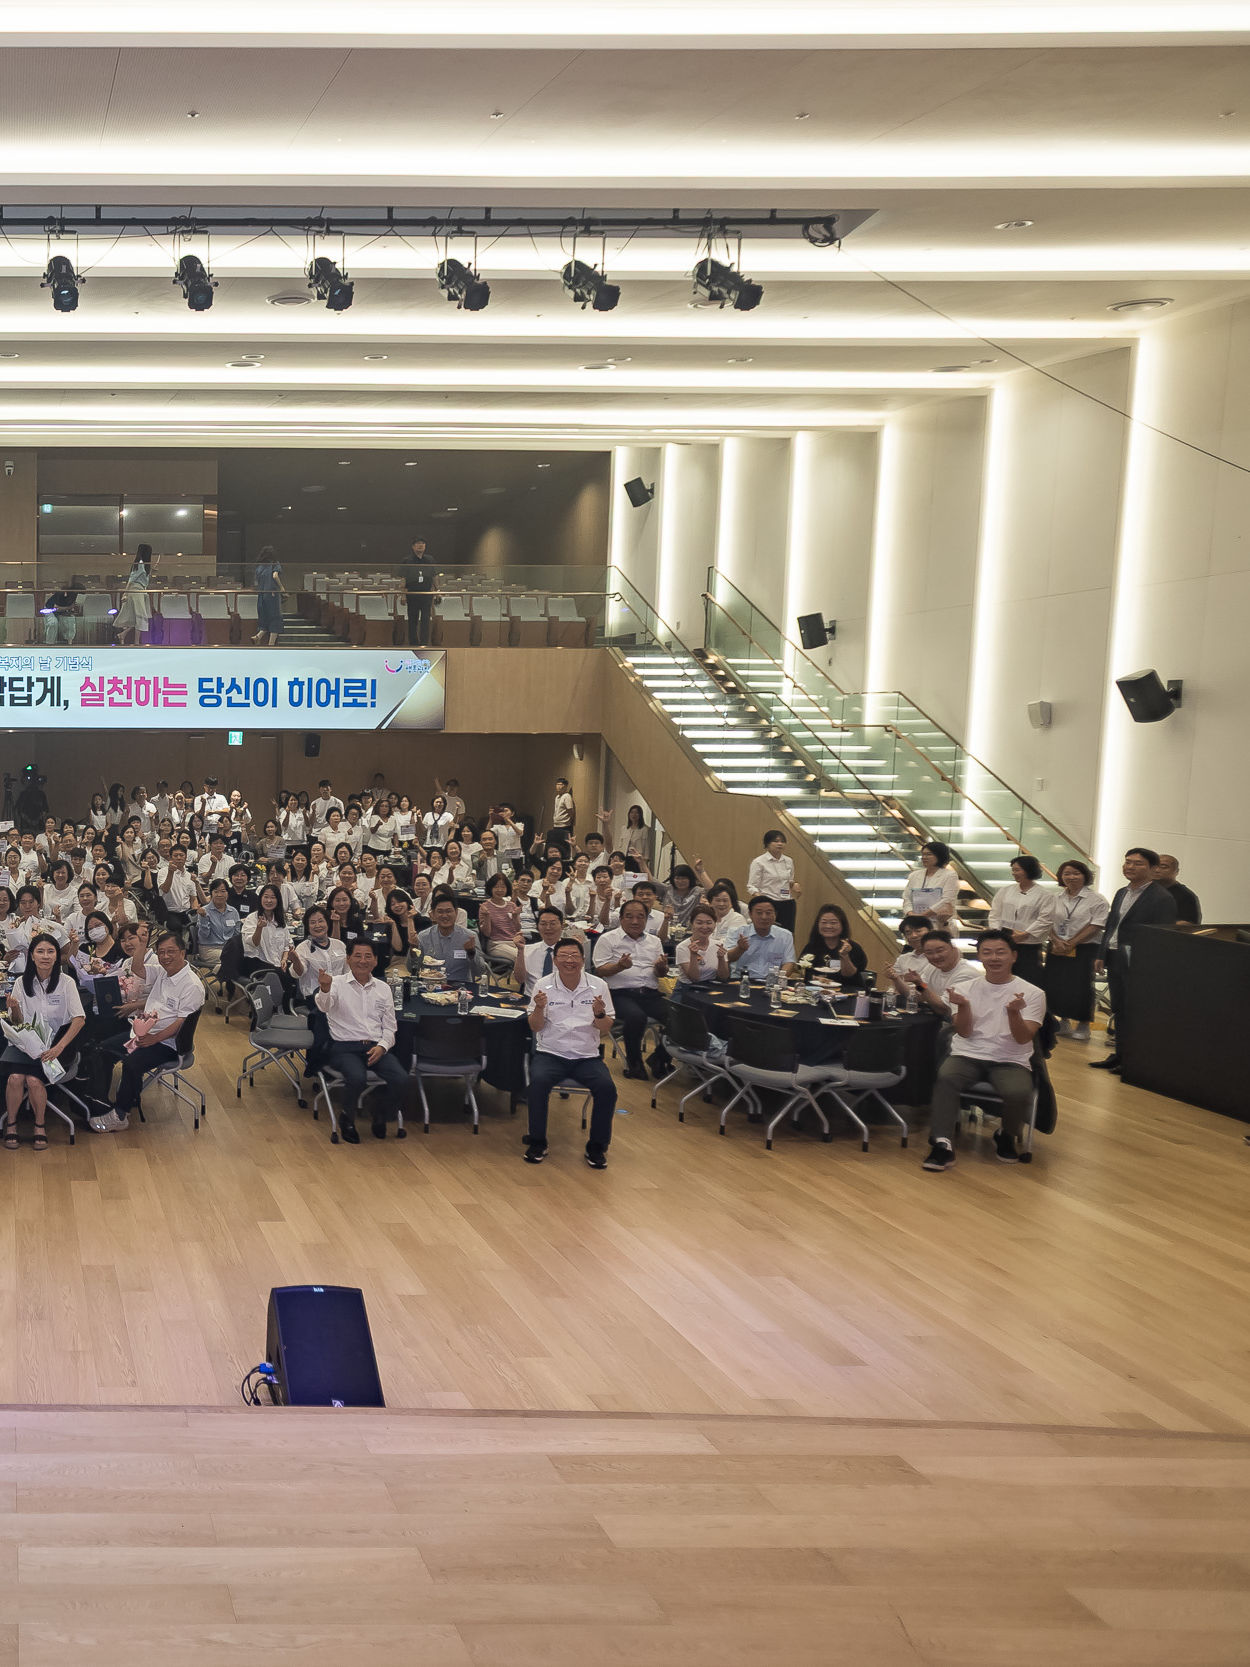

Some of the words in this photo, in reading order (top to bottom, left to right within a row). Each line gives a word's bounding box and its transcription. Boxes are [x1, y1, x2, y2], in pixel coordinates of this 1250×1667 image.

[39, 656, 52, 671] 날
[55, 656, 93, 671] 기념식
[79, 676, 187, 707] 실천하는
[197, 677, 277, 708] 당신이
[288, 677, 377, 708] 히어로!
